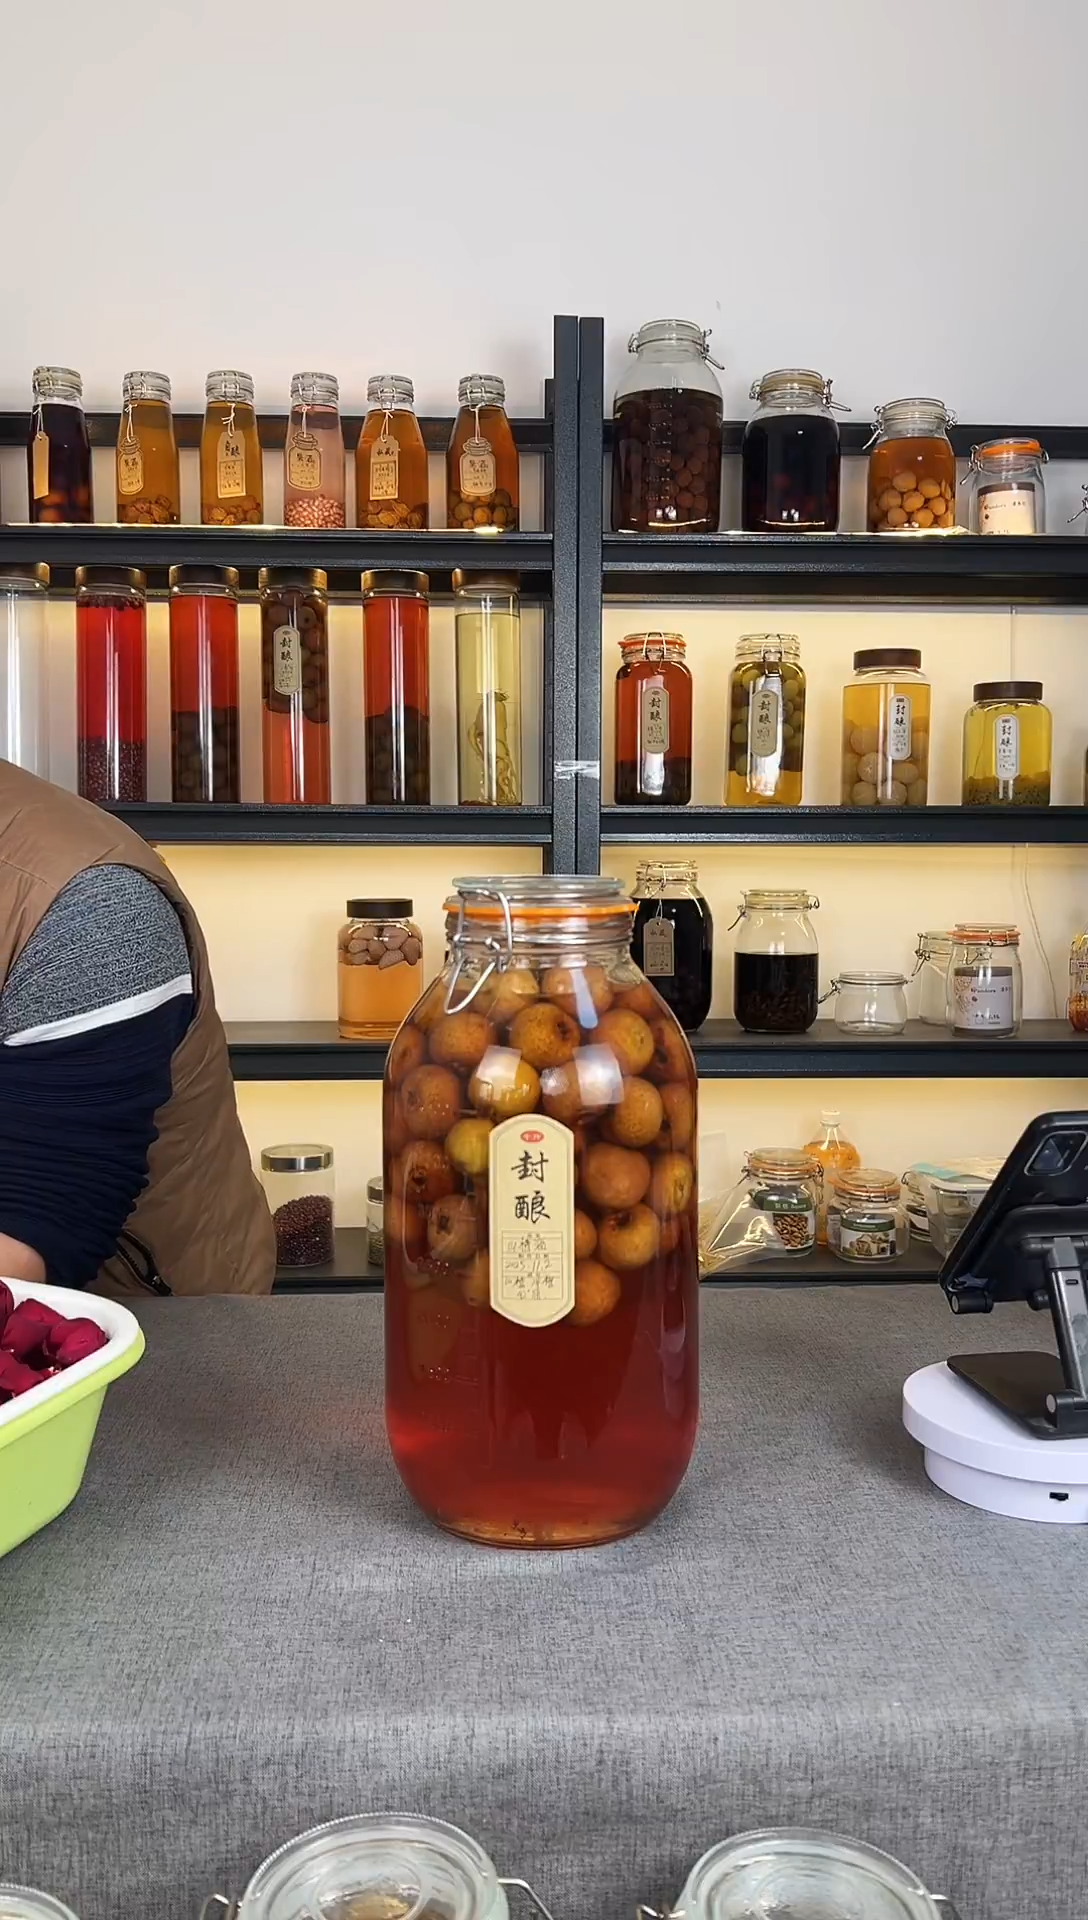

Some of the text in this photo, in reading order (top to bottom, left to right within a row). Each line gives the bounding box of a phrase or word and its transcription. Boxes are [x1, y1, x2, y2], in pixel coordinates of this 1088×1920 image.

[280, 636, 293, 662] 封酿
[649, 697, 662, 722] 封酿
[757, 700, 771, 725] 封酿
[511, 1149, 551, 1225] 封酿
